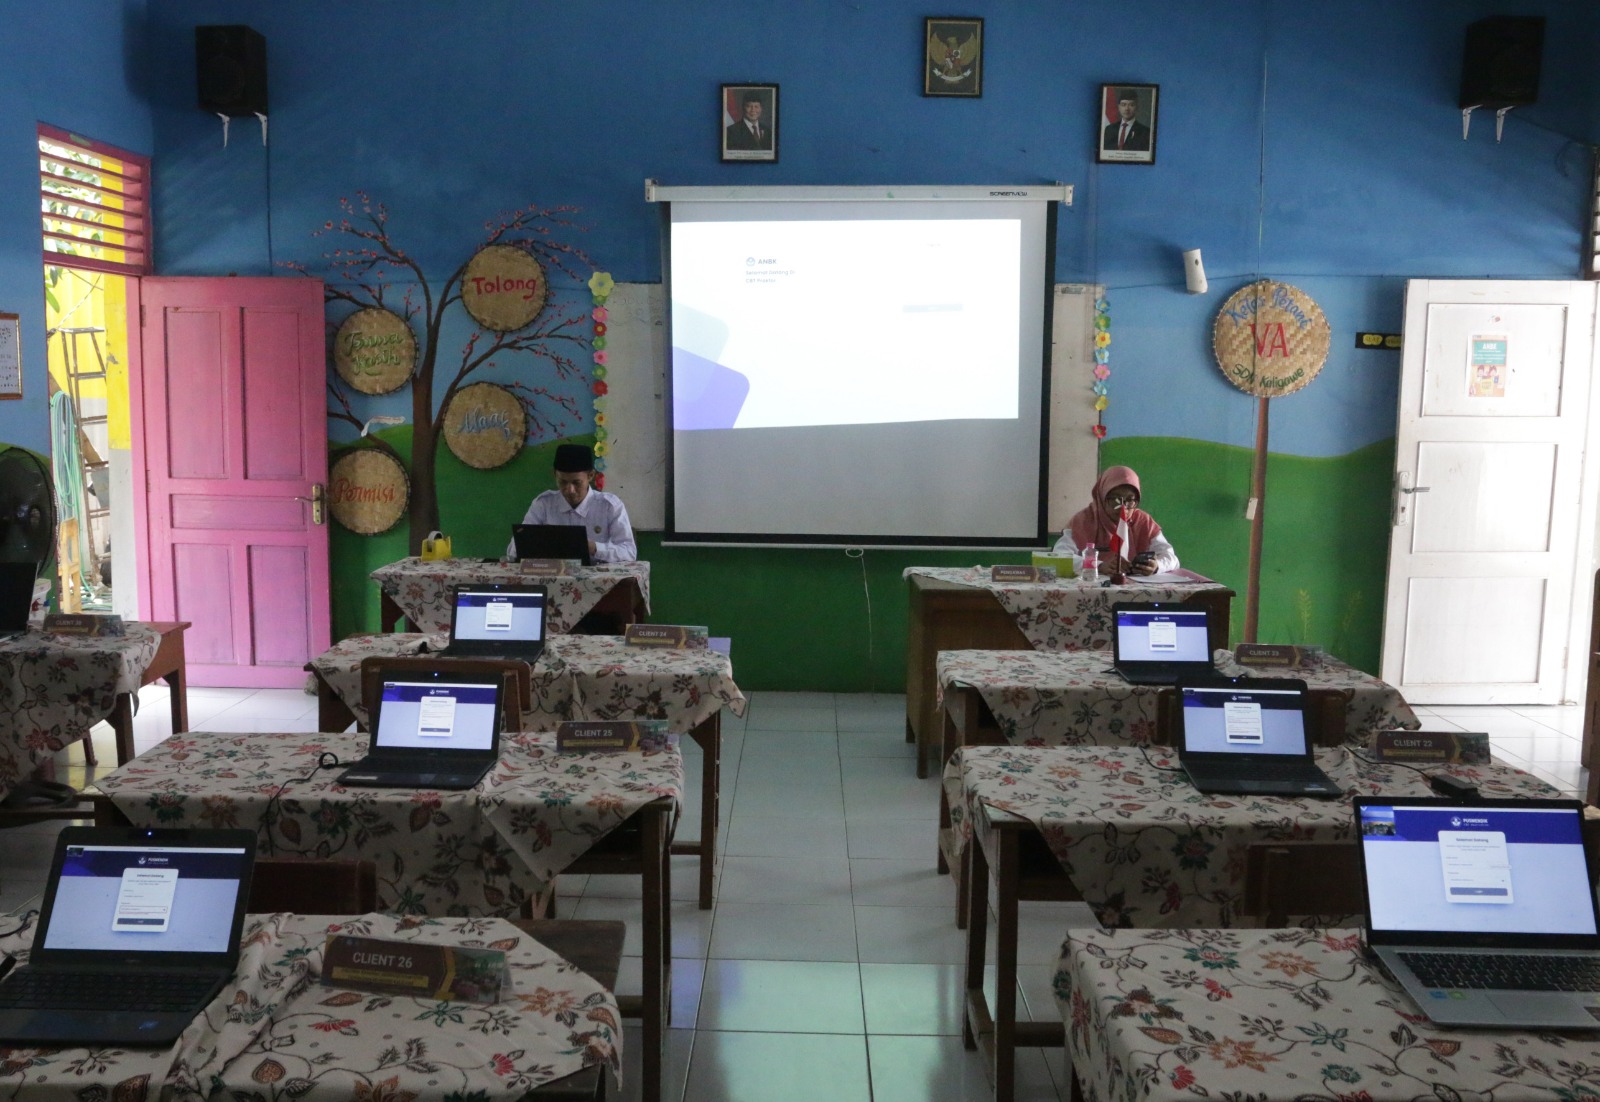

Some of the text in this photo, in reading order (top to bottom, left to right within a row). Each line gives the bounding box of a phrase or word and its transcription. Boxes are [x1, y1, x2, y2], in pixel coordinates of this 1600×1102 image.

[471, 275, 538, 300] Tolong
[1224, 286, 1313, 330] Kelas Petani
[344, 331, 404, 357] Terima
[1248, 323, 1290, 358] VA
[351, 350, 401, 376] Kasih
[1232, 363, 1305, 389] SDN Kaligawe
[459, 407, 511, 441] Maaf
[333, 478, 395, 504] Permisi
[574, 729, 613, 737] CLIENT 25
[1393, 739, 1421, 747] CLIENT
[353, 952, 414, 970] CLIENT 26
